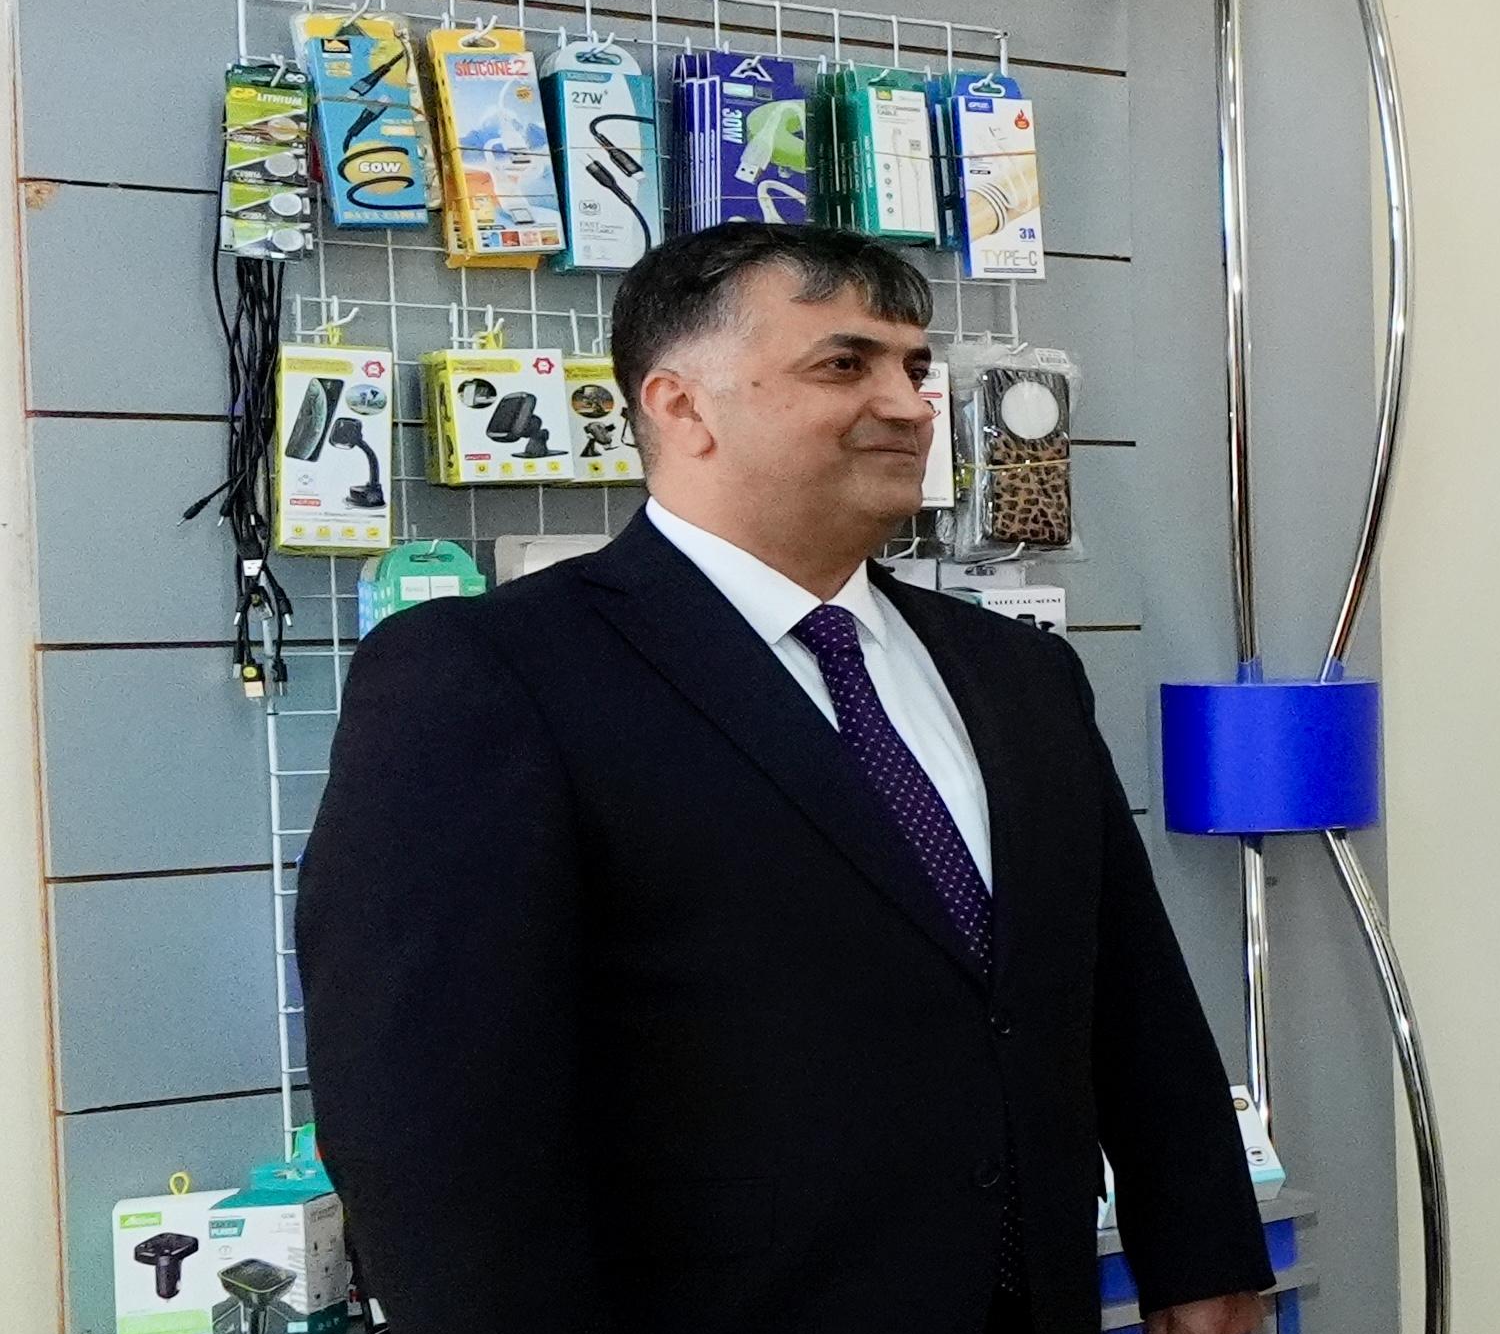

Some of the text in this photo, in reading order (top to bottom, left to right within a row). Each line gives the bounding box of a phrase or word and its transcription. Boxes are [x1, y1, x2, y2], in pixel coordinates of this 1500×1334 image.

[256, 92, 303, 106] LITHIUM
[721, 107, 743, 145] 30W
[359, 161, 401, 174] 60W
[1019, 227, 1036, 240] 3A
[981, 249, 1038, 267] TYPE-C
